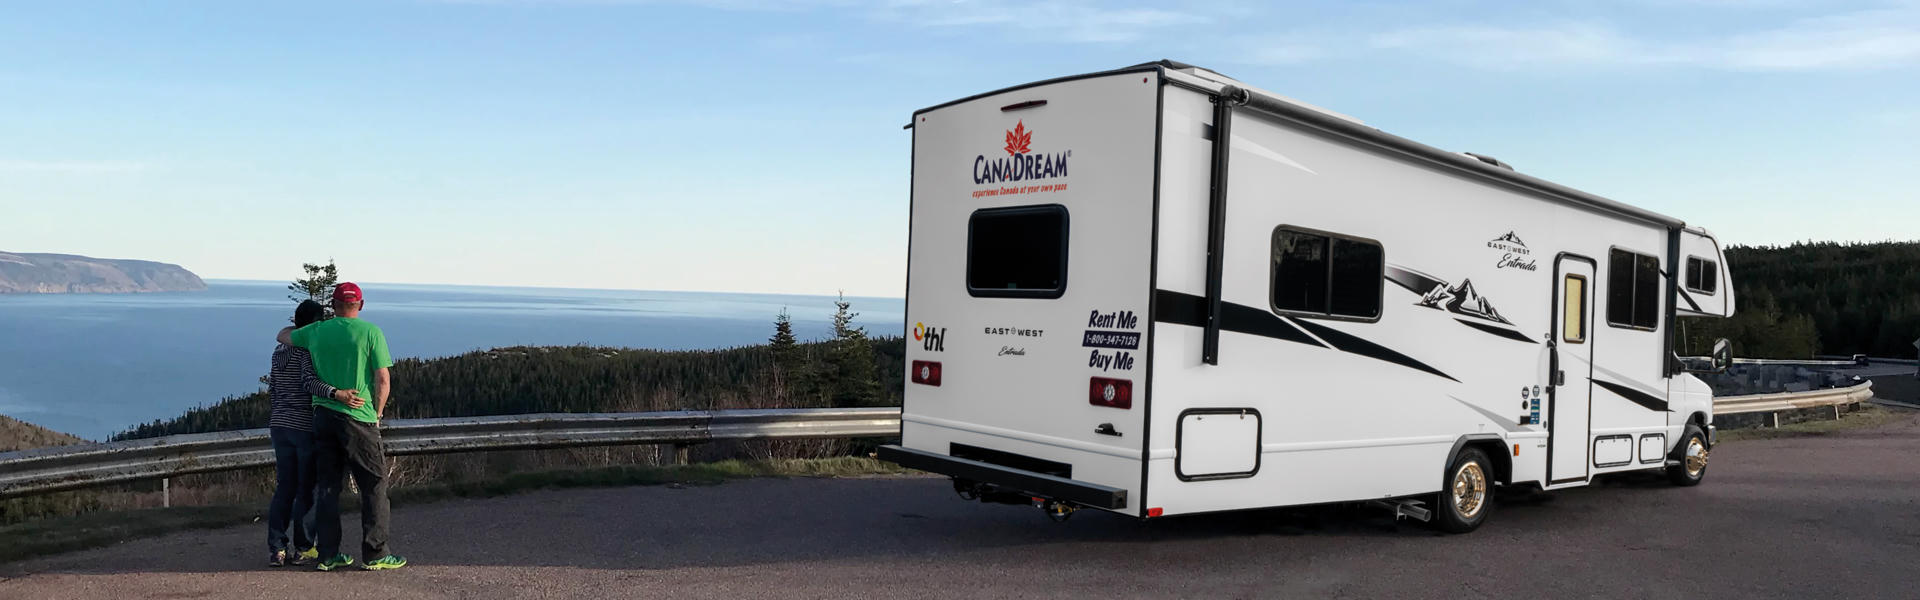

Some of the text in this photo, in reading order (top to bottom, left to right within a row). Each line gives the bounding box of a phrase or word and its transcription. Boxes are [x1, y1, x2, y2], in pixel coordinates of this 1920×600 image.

[1496, 252, 1536, 272] Entrada
[1088, 309, 1137, 329] Rent Me
[924, 326, 945, 352] thl
[984, 327, 1044, 338] EAST WEST
[1088, 349, 1134, 372] Buy Me
